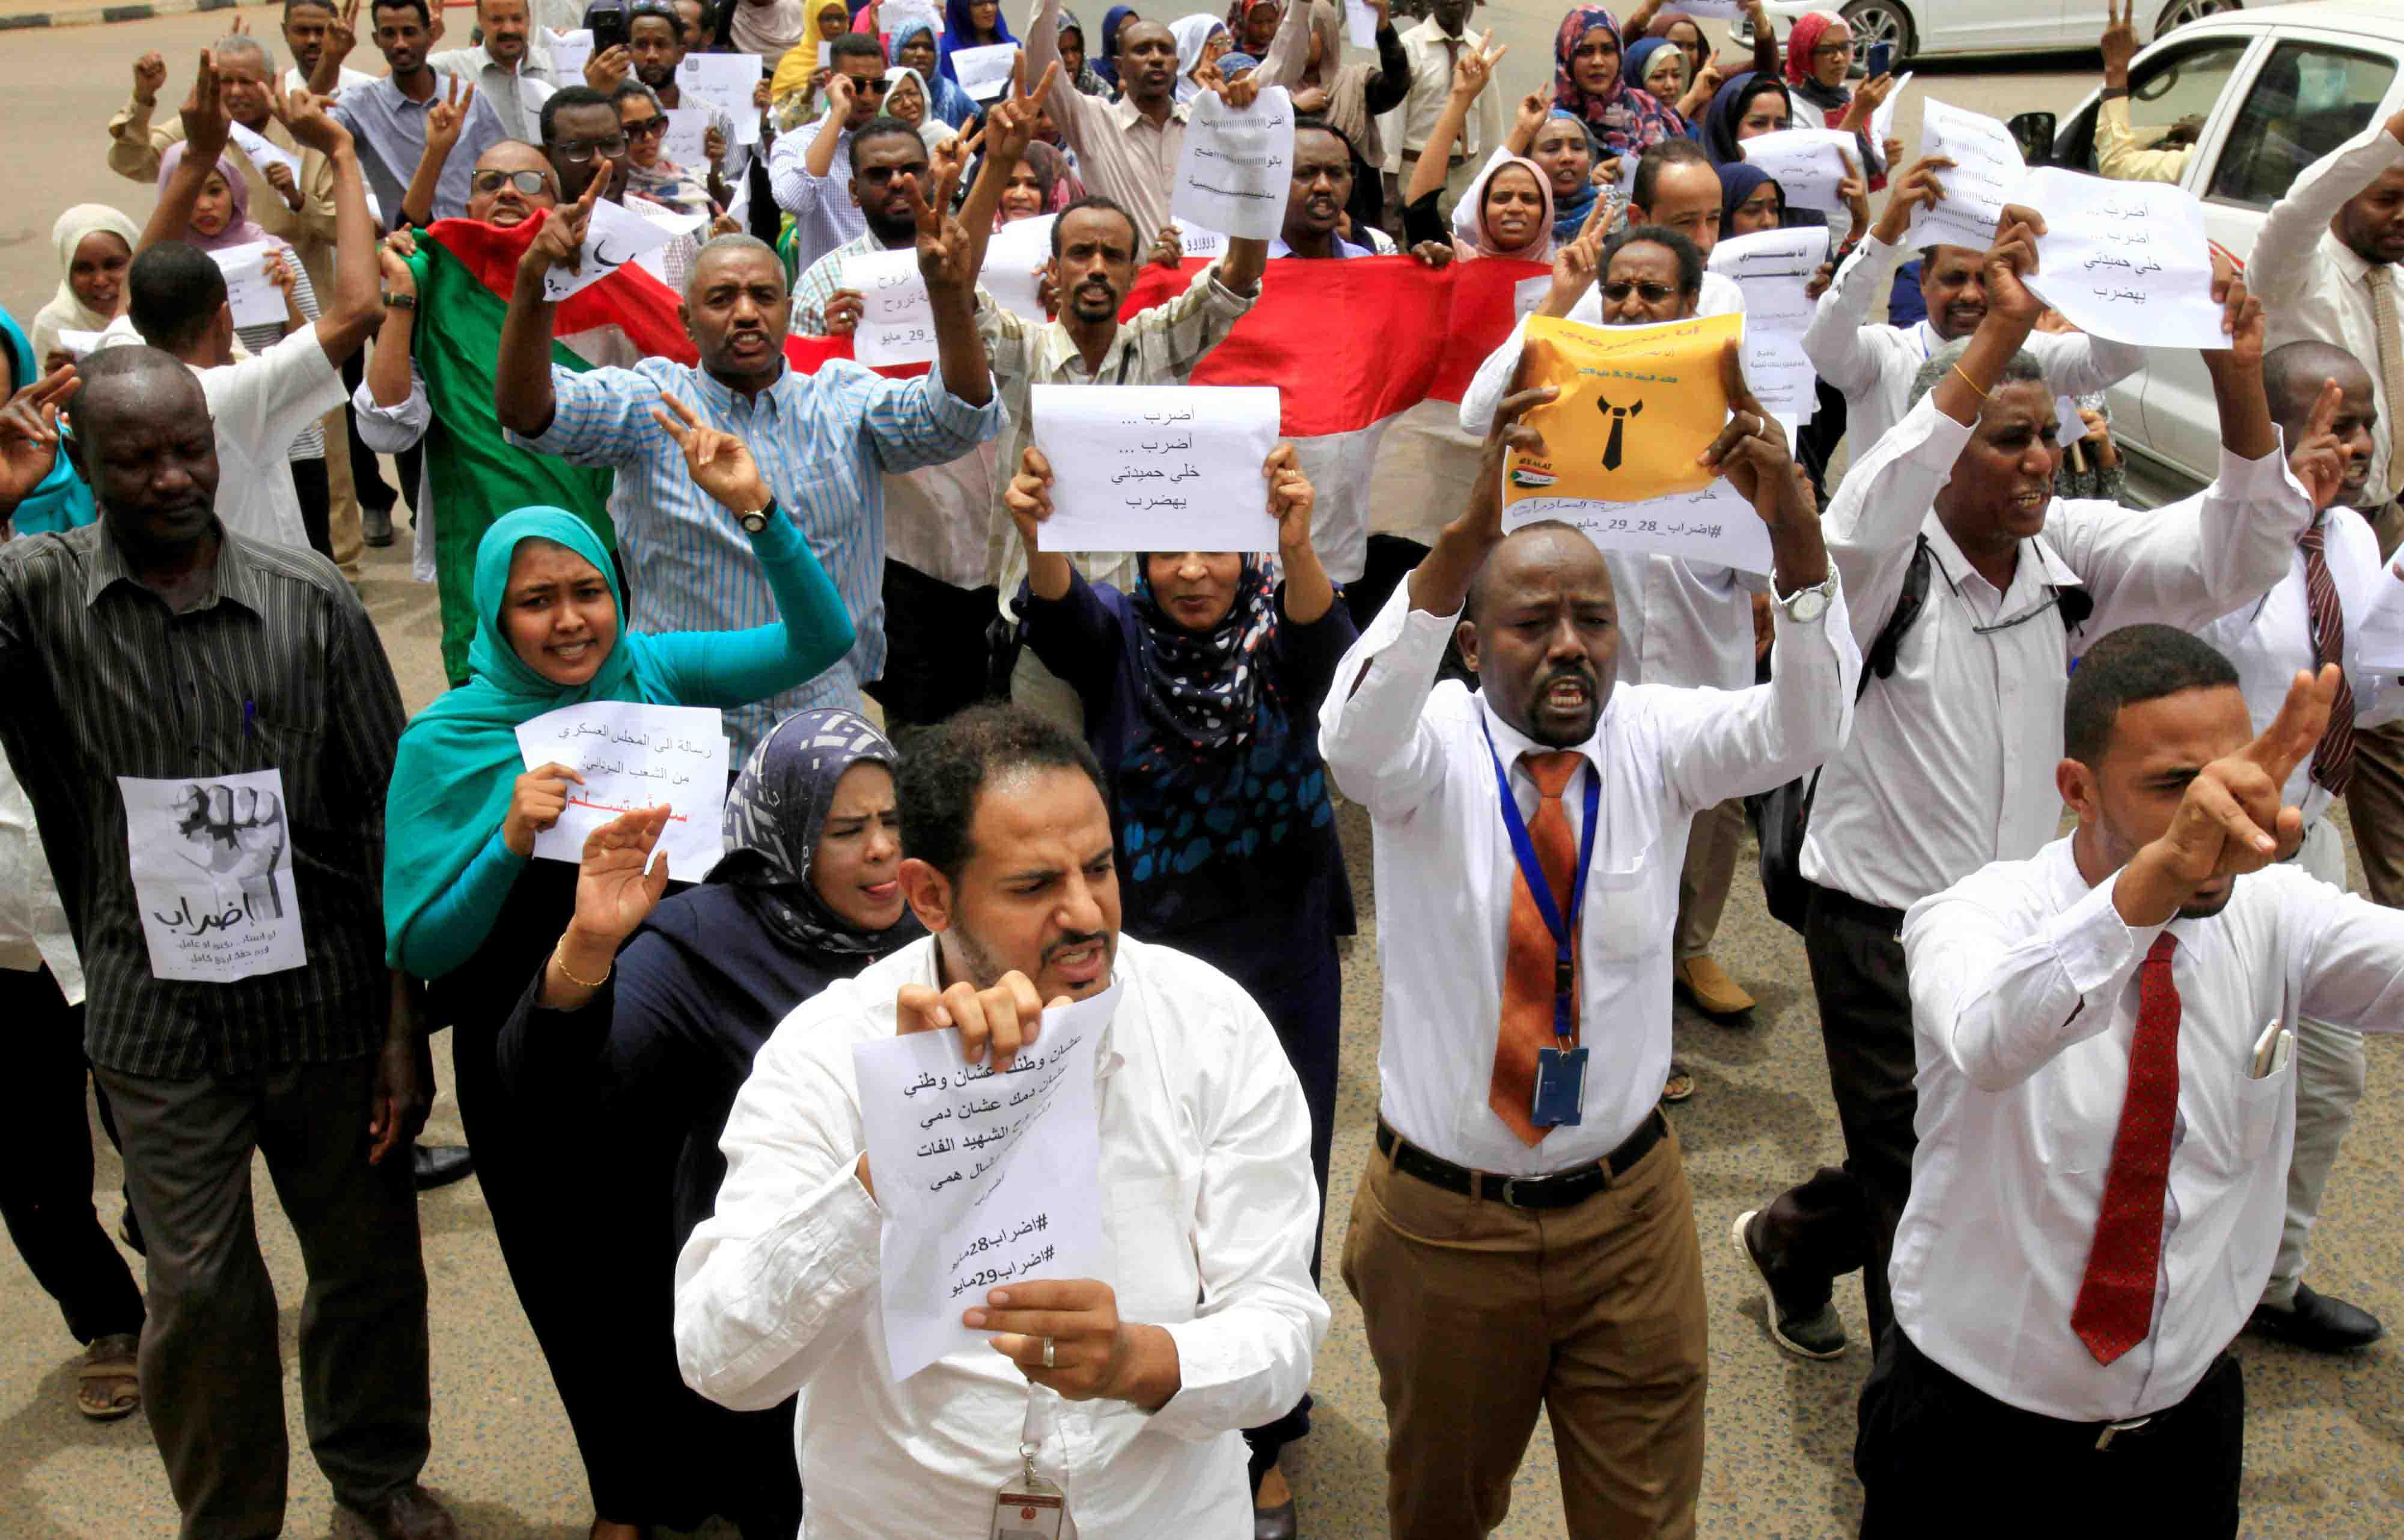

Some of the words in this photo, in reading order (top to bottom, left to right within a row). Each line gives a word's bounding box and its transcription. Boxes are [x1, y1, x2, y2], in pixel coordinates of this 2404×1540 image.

[2084, 251, 2131, 271] حميدتي
[2135, 255, 2162, 276] خلي
[2093, 285, 2147, 305] يهضرب
[1111, 466, 1165, 485] حميدتي
[1170, 463, 1201, 484] خلي
[1125, 494, 1187, 510] يهضرب
[557, 723, 609, 740] العسكري
[611, 729, 650, 746] المجلس
[677, 739, 712, 759] رسالة
[629, 765, 667, 779] الشعب
[672, 771, 690, 785] من
[153, 892, 256, 936] إضراب
[1050, 1035, 1082, 1063] عشان
[903, 1071, 948, 1097] وطني
[954, 1063, 995, 1088] عشان
[1008, 1087, 1036, 1107] دمك
[957, 1097, 1001, 1119] عشان
[920, 1107, 952, 1130] دمي
[917, 1137, 956, 1157] الفات
[962, 1125, 1009, 1150] الشهيد
[930, 1170, 963, 1193] همي
[948, 1244, 1055, 1298] #اضراب29مايو
